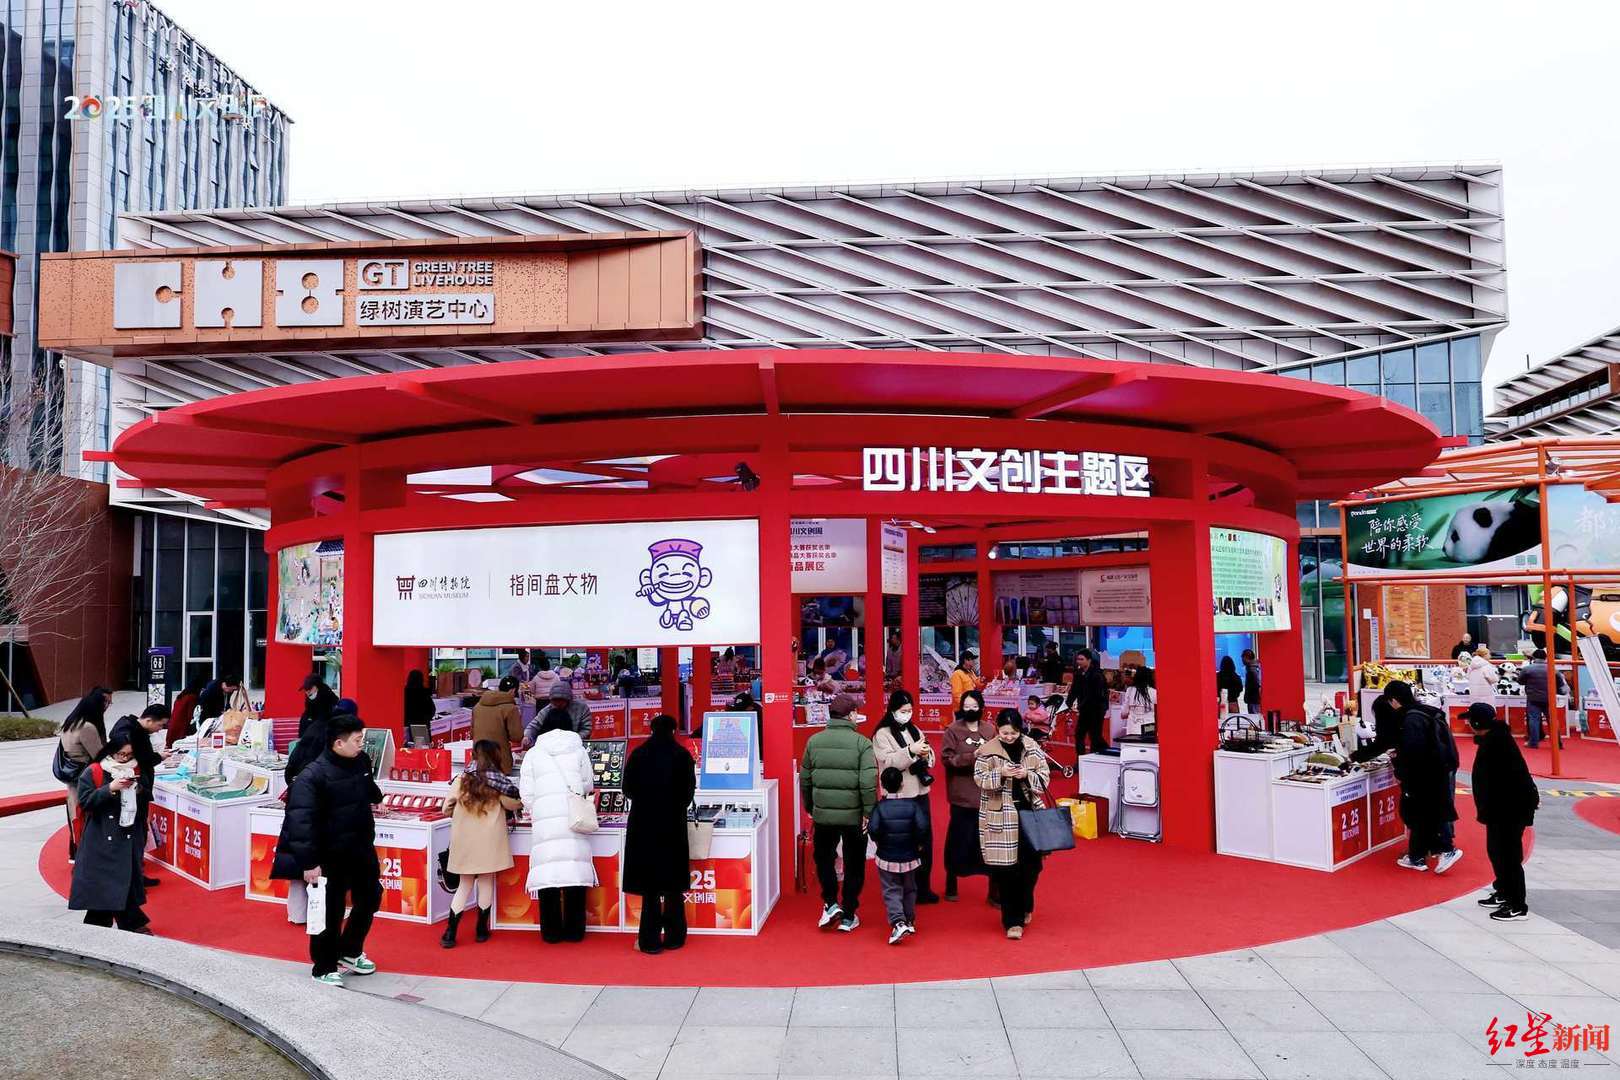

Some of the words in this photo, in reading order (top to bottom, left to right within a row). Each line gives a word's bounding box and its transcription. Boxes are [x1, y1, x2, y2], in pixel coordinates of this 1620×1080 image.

[362, 262, 404, 286] GT
[414, 262, 457, 274] GREEN
[460, 261, 494, 273] TREE
[414, 275, 494, 286] LIVEHOUSE
[360, 299, 489, 320] 绿树演艺中心
[863, 447, 1151, 498] 四川文创主题区
[790, 527, 823, 535] 川文创周
[1368, 512, 1424, 537] 陪你感受
[1361, 534, 1433, 559] 世界的柔软
[510, 573, 598, 596] 指间盘文物
